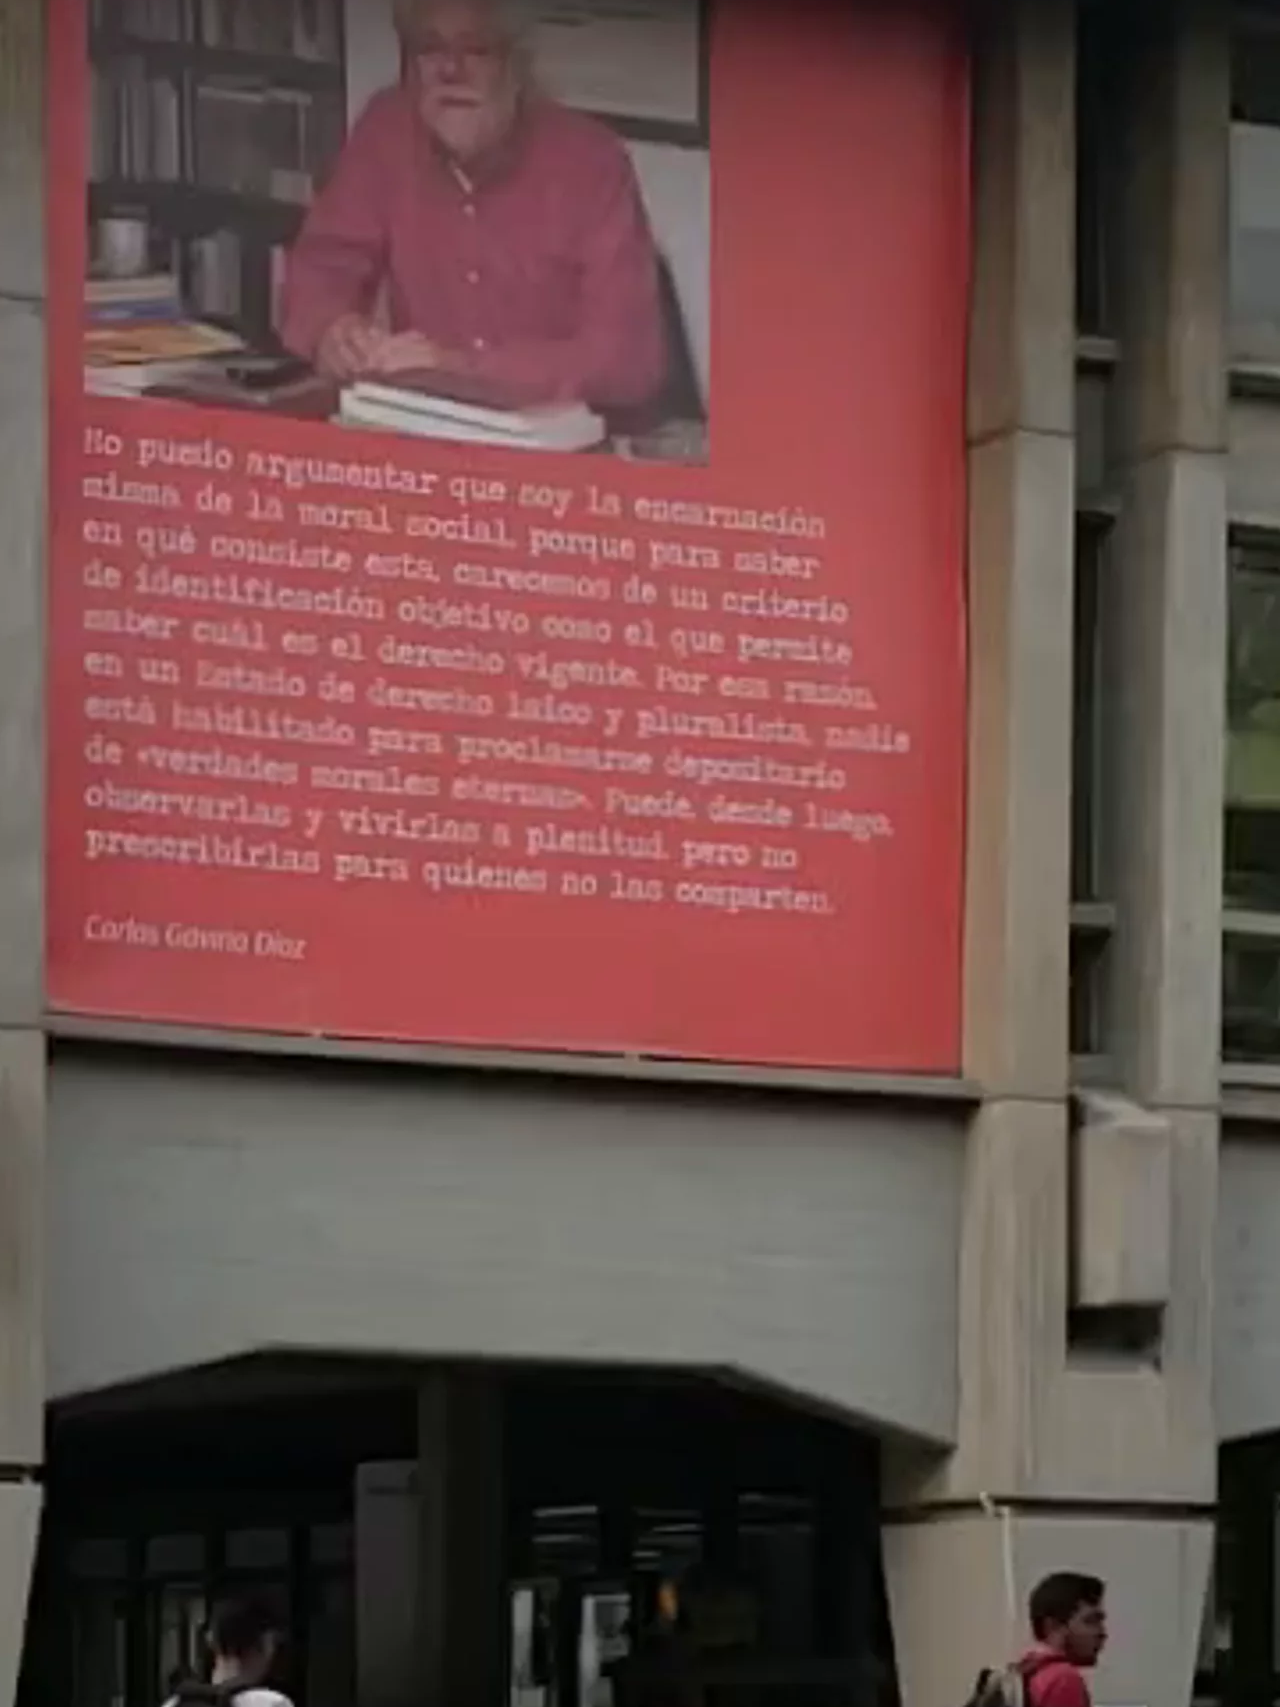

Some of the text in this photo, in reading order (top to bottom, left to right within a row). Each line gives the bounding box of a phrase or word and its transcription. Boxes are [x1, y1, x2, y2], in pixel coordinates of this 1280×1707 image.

[83, 471, 181, 509] misma
[195, 483, 232, 515] de
[245, 491, 284, 522] la
[299, 499, 392, 535] moral
[529, 524, 635, 567] porque
[648, 538, 721, 571] para
[734, 547, 821, 582] saber
[84, 427, 826, 540] No puedo argumentar que soy la encarnación
[82, 518, 122, 545] en
[137, 524, 197, 558] qué
[210, 533, 352, 572] consiste
[453, 561, 612, 599] carecemos
[622, 573, 657, 605] de
[670, 583, 709, 611] un
[722, 587, 849, 624] criterio
[82, 556, 852, 666] de identificación objetivo como el que permite
[83, 605, 179, 639] saber
[193, 614, 269, 649] cuál
[281, 630, 319, 656] es
[330, 631, 366, 662] el
[376, 634, 505, 675] derecho
[656, 663, 710, 694] Por
[719, 676, 770, 702] esa
[83, 651, 122, 676] en
[139, 656, 180, 684] un
[196, 658, 305, 698] Estado
[318, 671, 355, 703] de
[368, 678, 494, 717] derecho
[507, 691, 593, 727] laico
[604, 705, 624, 737] y
[825, 719, 911, 754] nadie
[84, 695, 156, 726] está
[172, 699, 355, 745] habilitado
[367, 726, 443, 756] para
[663, 746, 846, 790] depositario
[84, 733, 122, 765] de
[311, 763, 441, 797] morales
[708, 795, 793, 828] desde
[84, 781, 292, 828] observarlas
[305, 807, 322, 840] y
[339, 804, 480, 843] vivirlas
[493, 827, 510, 847] a
[682, 838, 749, 869] pero
[761, 845, 798, 870] no
[84, 828, 835, 916] prescribirlas para quienes no las comparten.
[85, 915, 159, 947] Carlos
